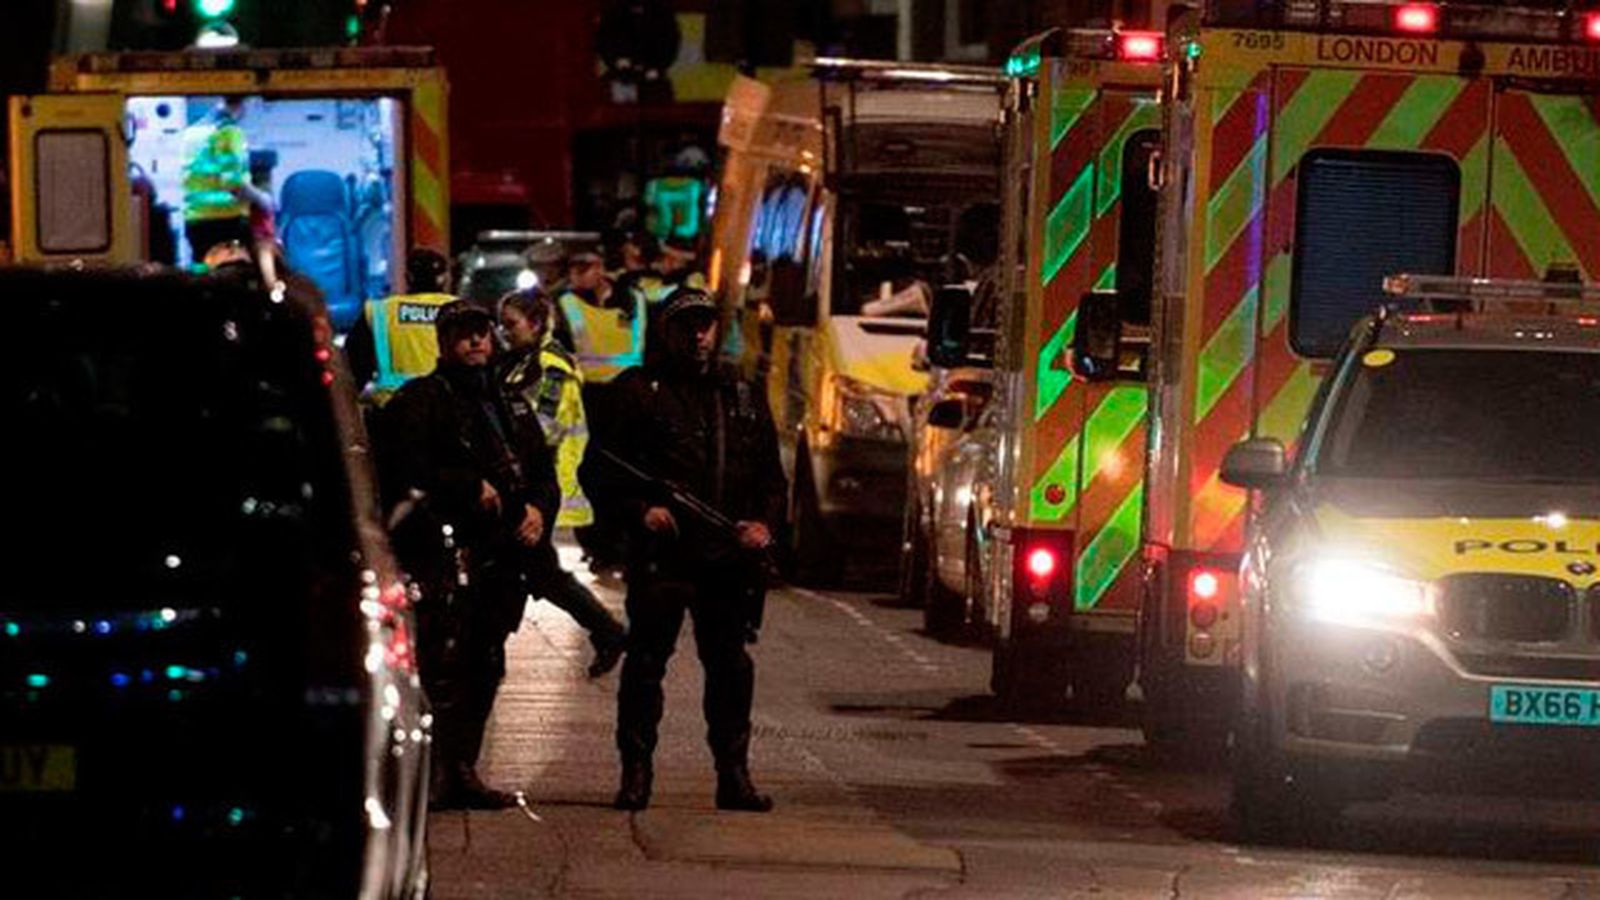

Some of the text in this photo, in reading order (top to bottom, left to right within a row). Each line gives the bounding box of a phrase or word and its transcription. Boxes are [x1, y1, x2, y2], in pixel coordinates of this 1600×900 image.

[1317, 38, 1438, 65] LONDON
[1507, 46, 1600, 72] AMBU
[1506, 690, 1581, 719] BX66
